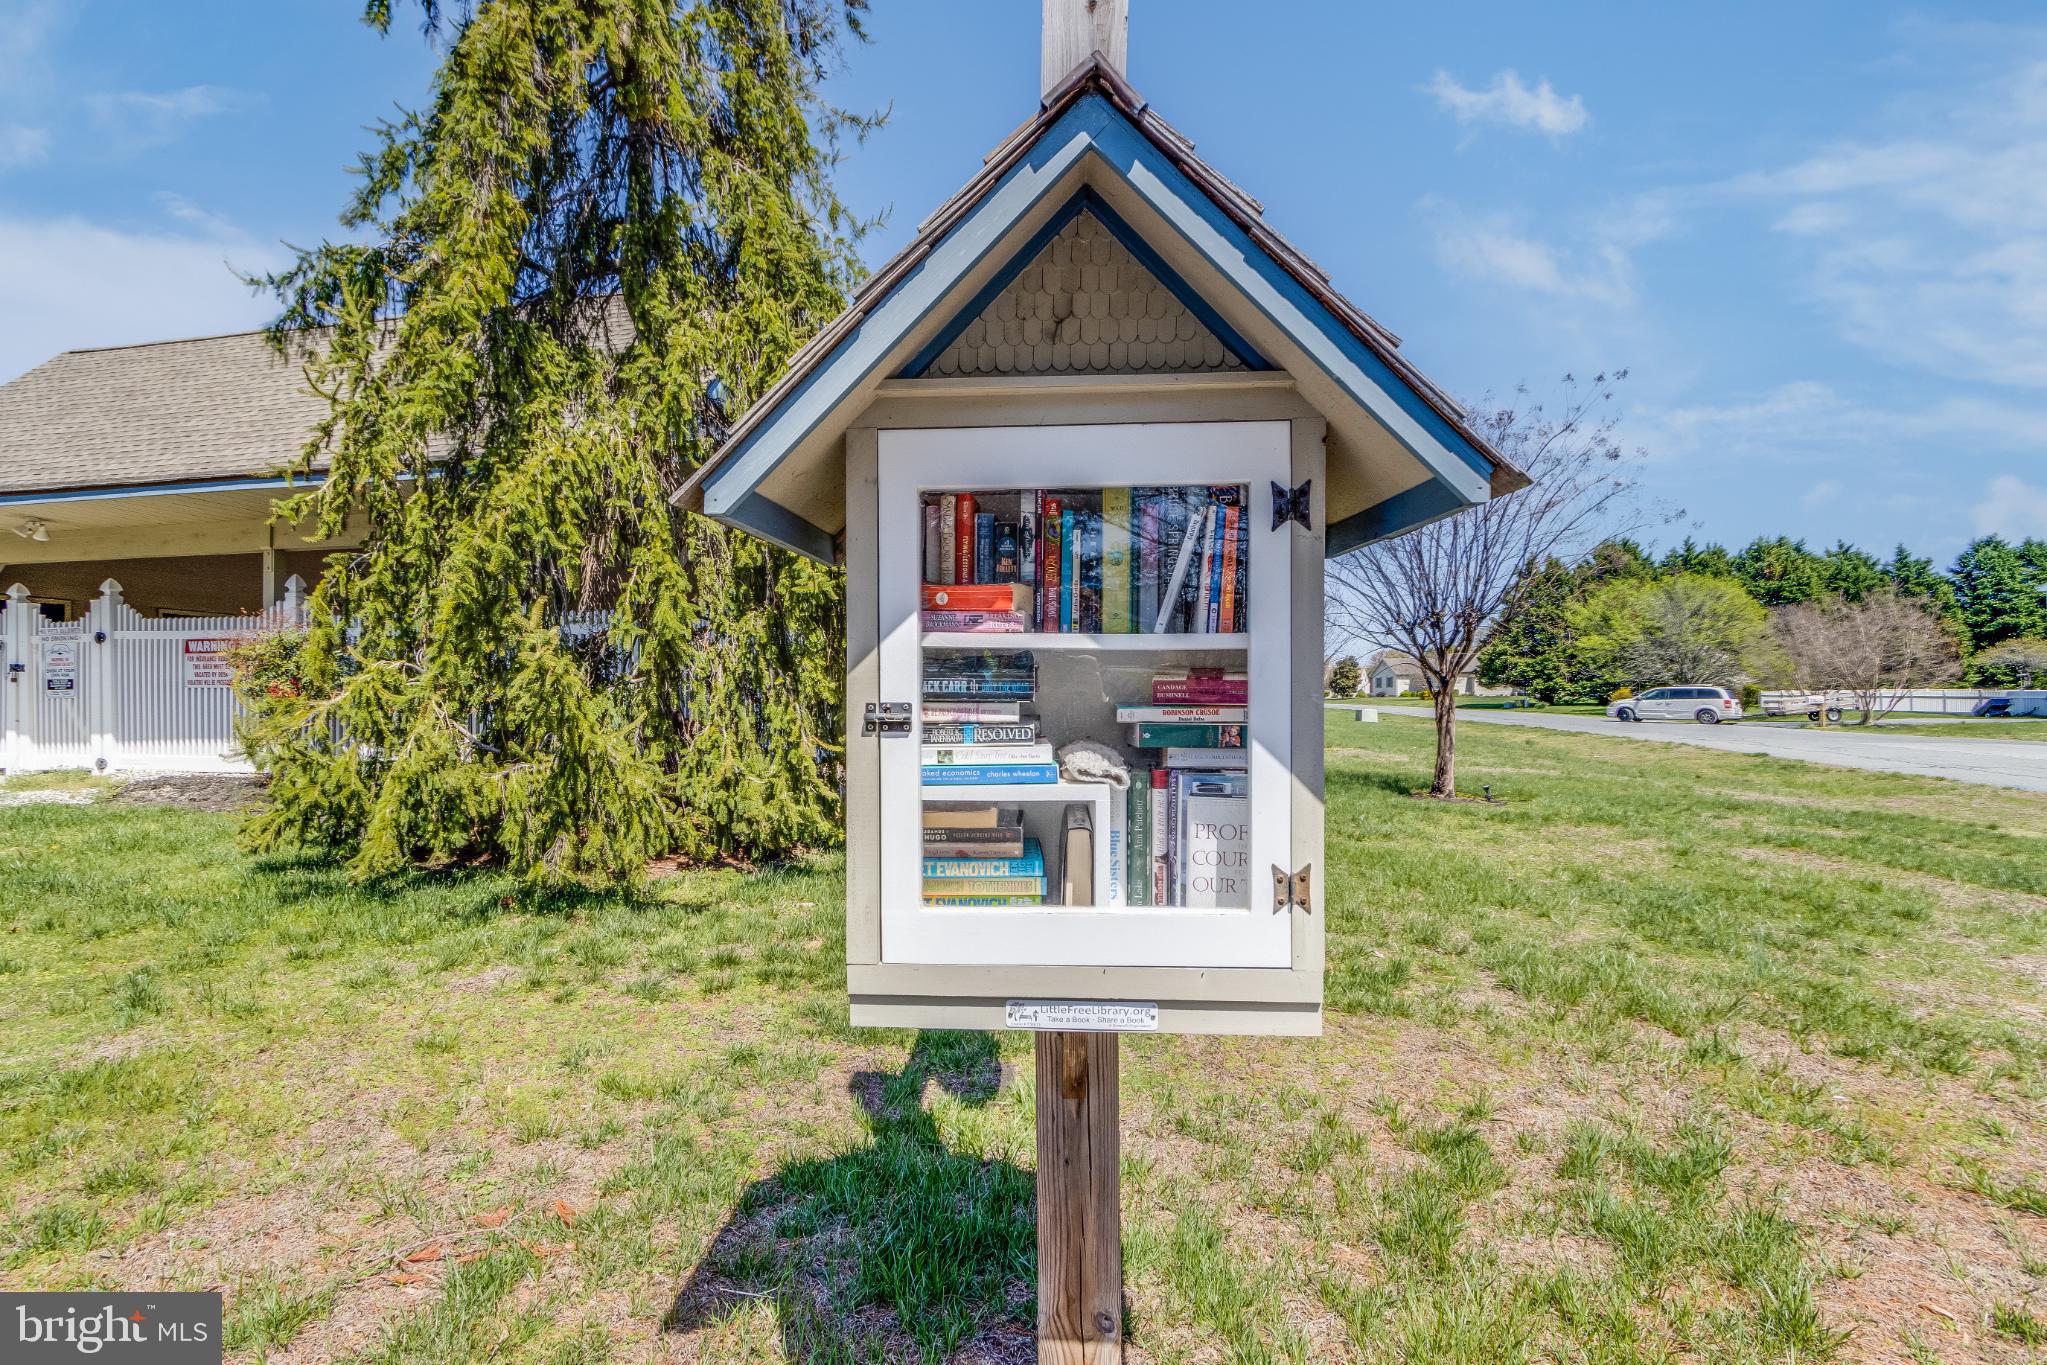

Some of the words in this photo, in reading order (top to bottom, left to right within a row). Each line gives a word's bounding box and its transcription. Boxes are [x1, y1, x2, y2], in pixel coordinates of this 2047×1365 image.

[961, 535, 969, 553] FLYING
[961, 555, 969, 579] LESSONS
[923, 681, 940, 693] ACK
[942, 680, 967, 693] CARR
[974, 727, 1031, 742] RESOLVED
[922, 769, 940, 777] aked
[942, 769, 981, 777] economics
[986, 769, 1010, 778] charles
[1012, 769, 1041, 778] wheelan
[1134, 799, 1143, 831] Patchett
[1110, 830, 1120, 858] Blue
[1134, 834, 1143, 850] Ann
[1192, 850, 1248, 868] COUR
[936, 861, 1009, 876] EVANOVICH
[1110, 860, 1120, 900] Sisters
[1192, 876, 1237, 894] OUR
[1041, 1004, 1151, 1018] LittleFreeLibrary.org
